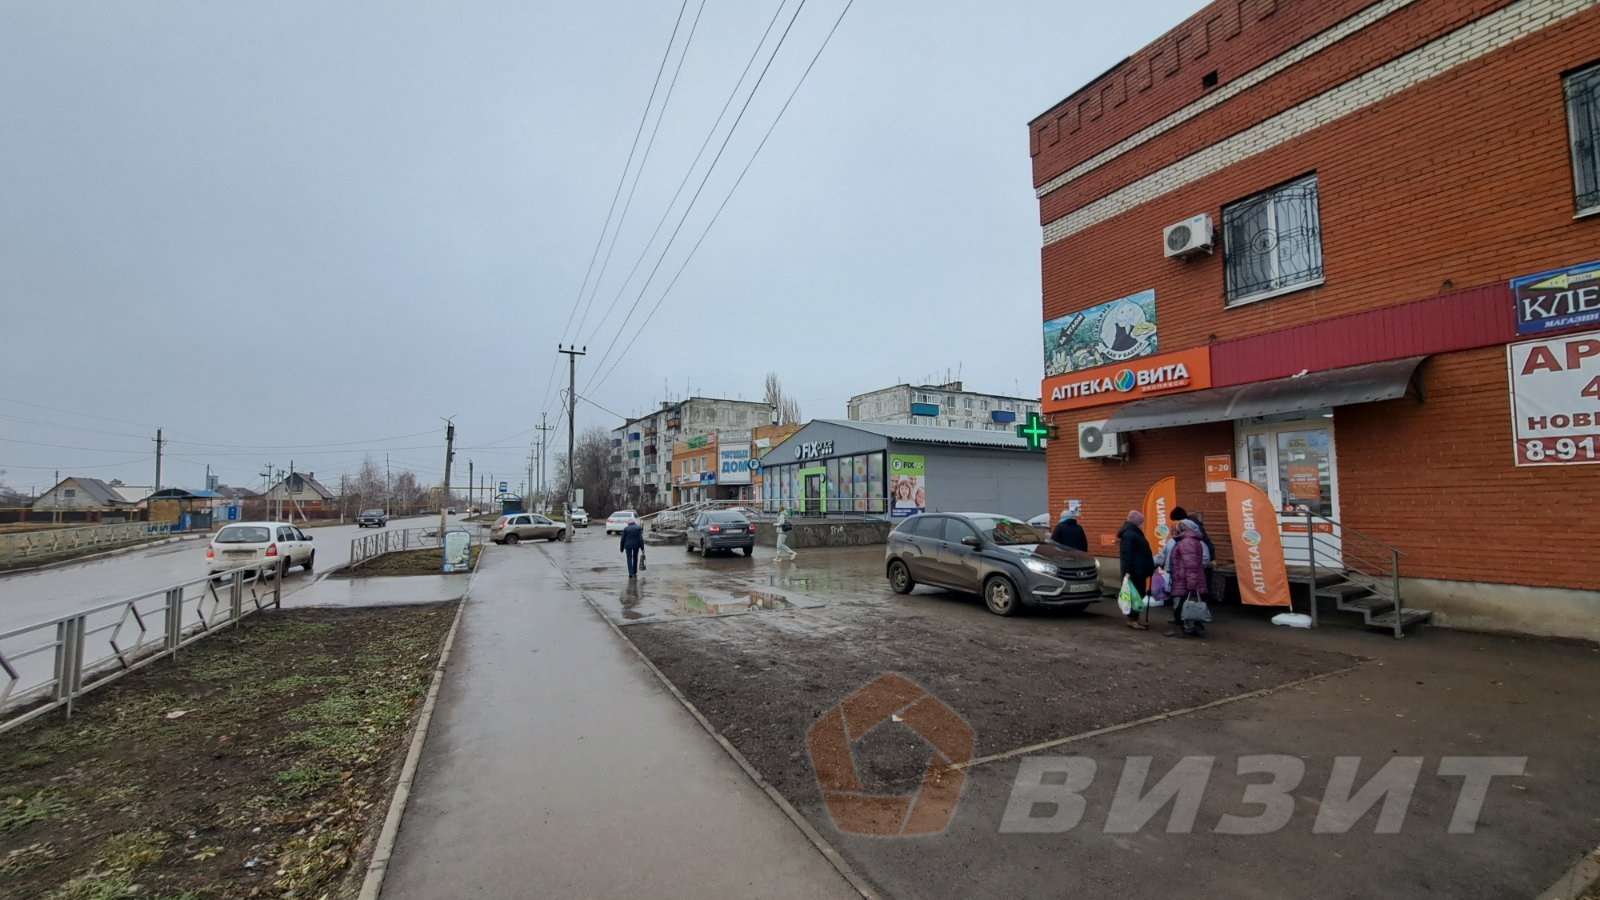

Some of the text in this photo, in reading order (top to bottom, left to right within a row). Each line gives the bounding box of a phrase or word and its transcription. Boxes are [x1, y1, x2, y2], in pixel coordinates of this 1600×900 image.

[1051, 362, 1189, 401] АПТЕКА ВИТА
[802, 441, 819, 459] FIX
[1525, 437, 1595, 461] 8-91
[721, 460, 749, 473] ДОМ
[1240, 498, 1266, 593] АПТЕКА ВИТА
